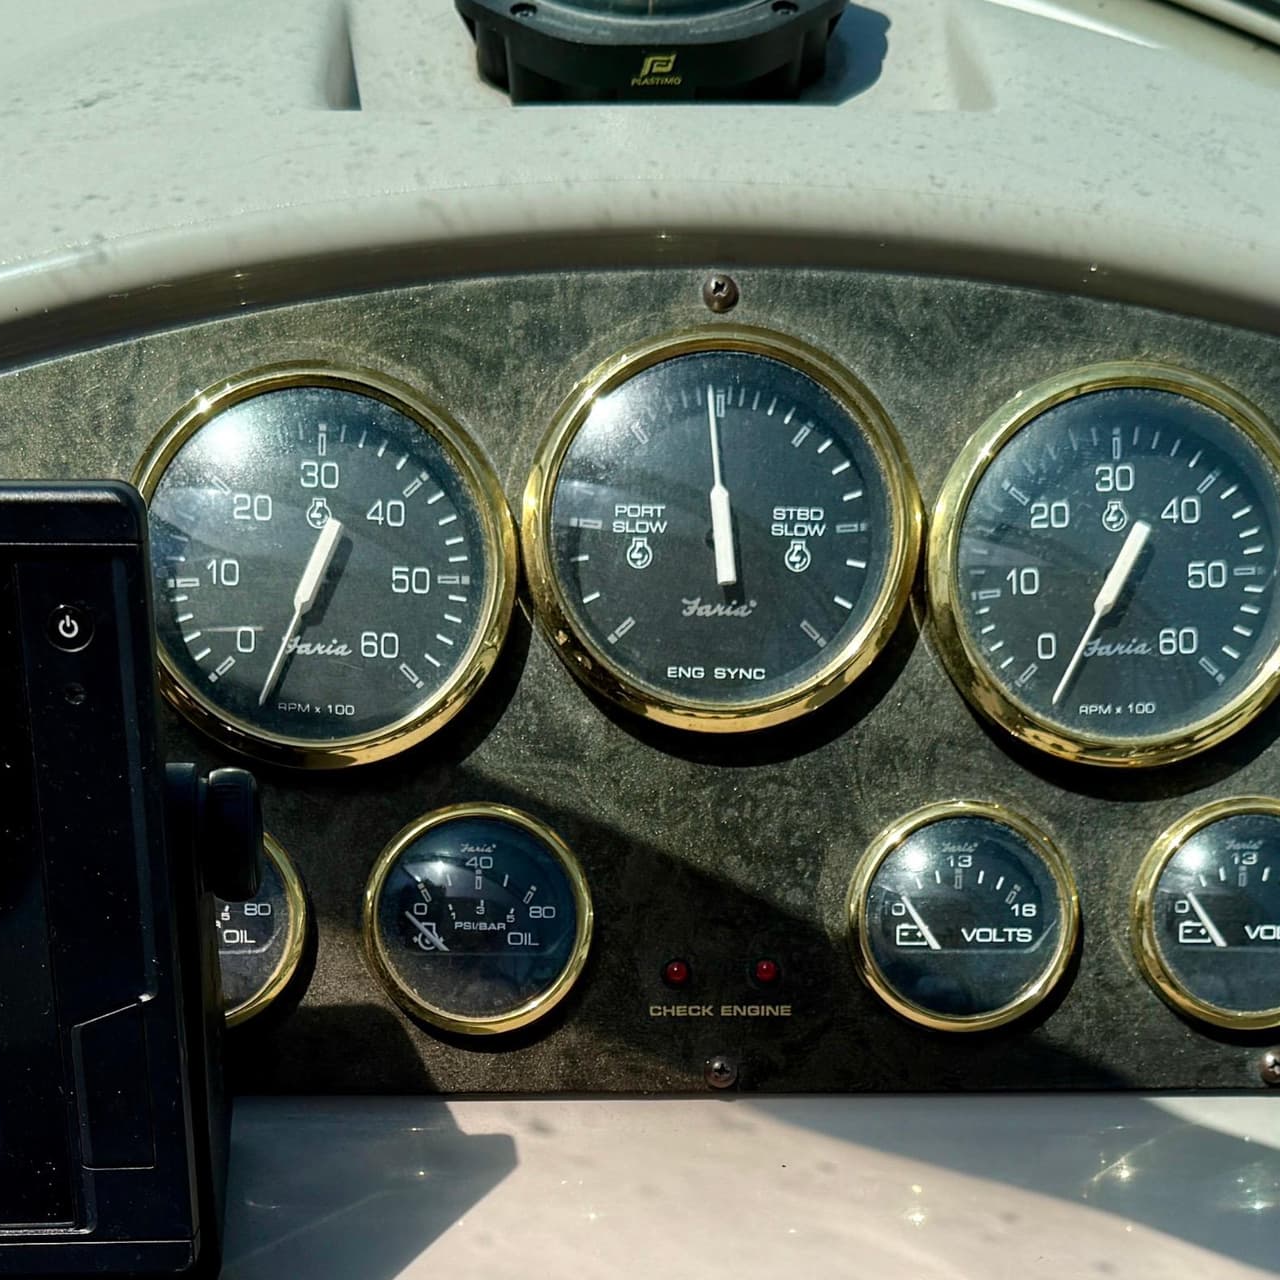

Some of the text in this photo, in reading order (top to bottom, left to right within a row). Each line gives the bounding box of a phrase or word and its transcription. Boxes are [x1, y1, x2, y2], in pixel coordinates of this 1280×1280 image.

[631, 76, 681, 85] PLASTIMO
[300, 463, 339, 488] 30
[1095, 466, 1133, 491] 30
[233, 495, 272, 520] 20
[366, 501, 405, 526] 40
[615, 505, 665, 518] PORT
[773, 508, 824, 521] STBD
[1030, 503, 1069, 528] 20
[1161, 498, 1200, 524] 40
[612, 521, 667, 534] SLOW
[771, 524, 826, 536] SLOW
[207, 560, 240, 585] 10
[391, 568, 430, 594] 50
[1006, 568, 1040, 595] 10
[1187, 562, 1226, 588] 50
[360, 633, 399, 658] 60
[1159, 629, 1198, 655] 60
[667, 667, 766, 680] ENG SYNC
[507, 932, 539, 945] OIL
[961, 928, 1032, 943] VOLTS
[649, 1005, 791, 1017] CHECK ENGINE
